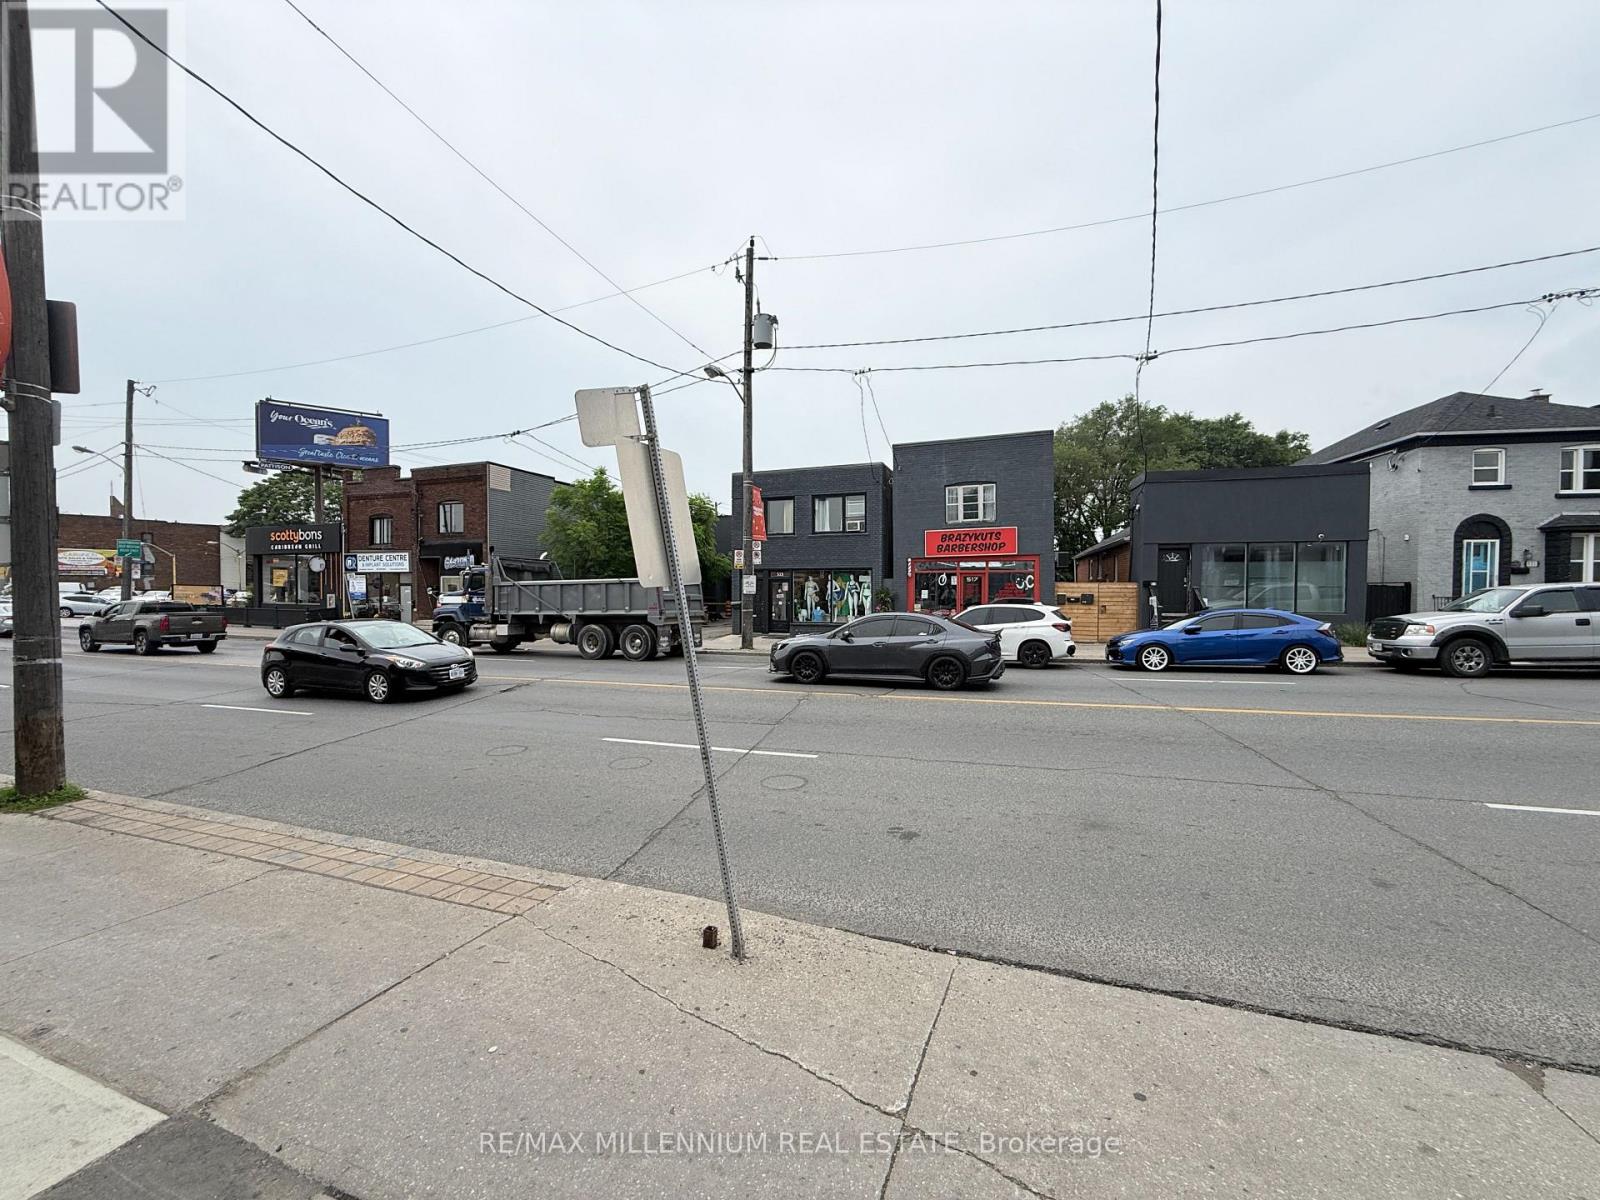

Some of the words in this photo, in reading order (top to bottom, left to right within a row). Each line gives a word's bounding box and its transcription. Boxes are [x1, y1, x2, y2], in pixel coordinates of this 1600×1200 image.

[270, 410, 293, 422] Your
[260, 463, 291, 471] PATTISON
[270, 528, 323, 543] scottybons
[940, 531, 1002, 543] BRAZYKUTS
[936, 541, 1006, 553] BARBERSHOP
[358, 554, 384, 562] DENTURE
